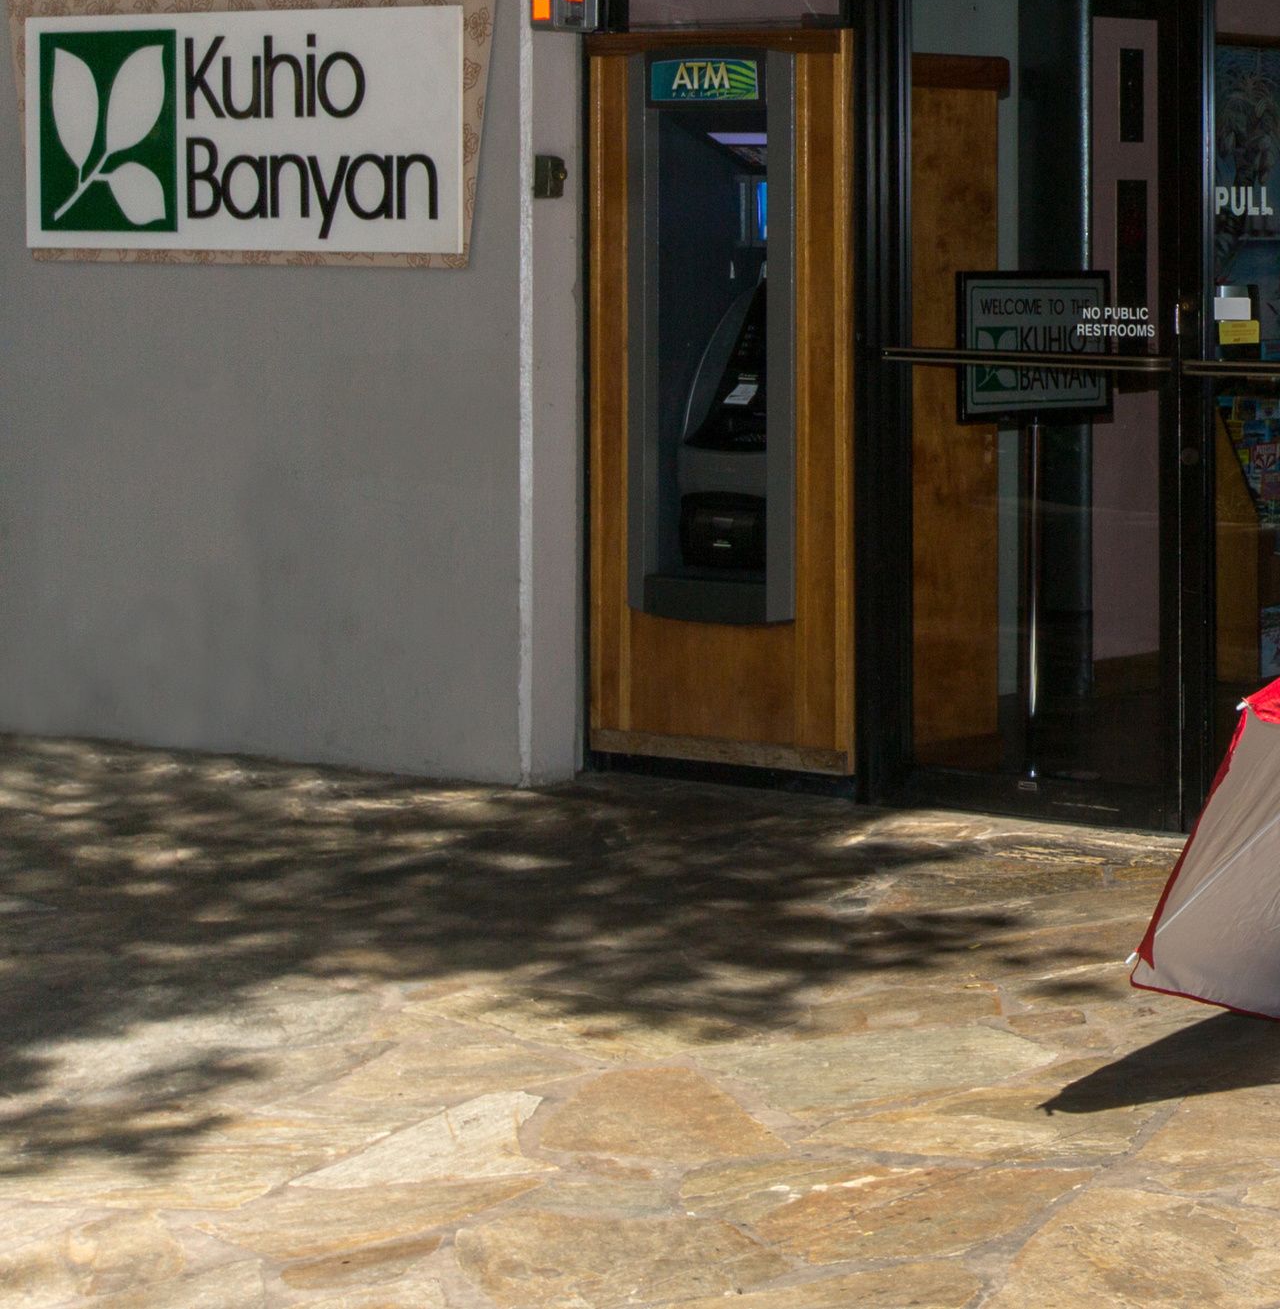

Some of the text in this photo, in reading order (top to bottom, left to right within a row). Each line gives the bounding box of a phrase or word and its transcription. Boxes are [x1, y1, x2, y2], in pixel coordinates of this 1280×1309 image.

[184, 33, 366, 120] Kuhio
[671, 61, 731, 90] ATM
[185, 137, 439, 240] Banyan
[1215, 186, 1274, 216] PULL
[980, 298, 1042, 315] WELCOME
[1049, 298, 1065, 315] TO
[1082, 307, 1149, 320] NO PUBLIC
[1020, 326, 1087, 353] KUHIO
[1076, 324, 1155, 337] RESTROOMS
[1020, 366, 1097, 391] BANYAN
